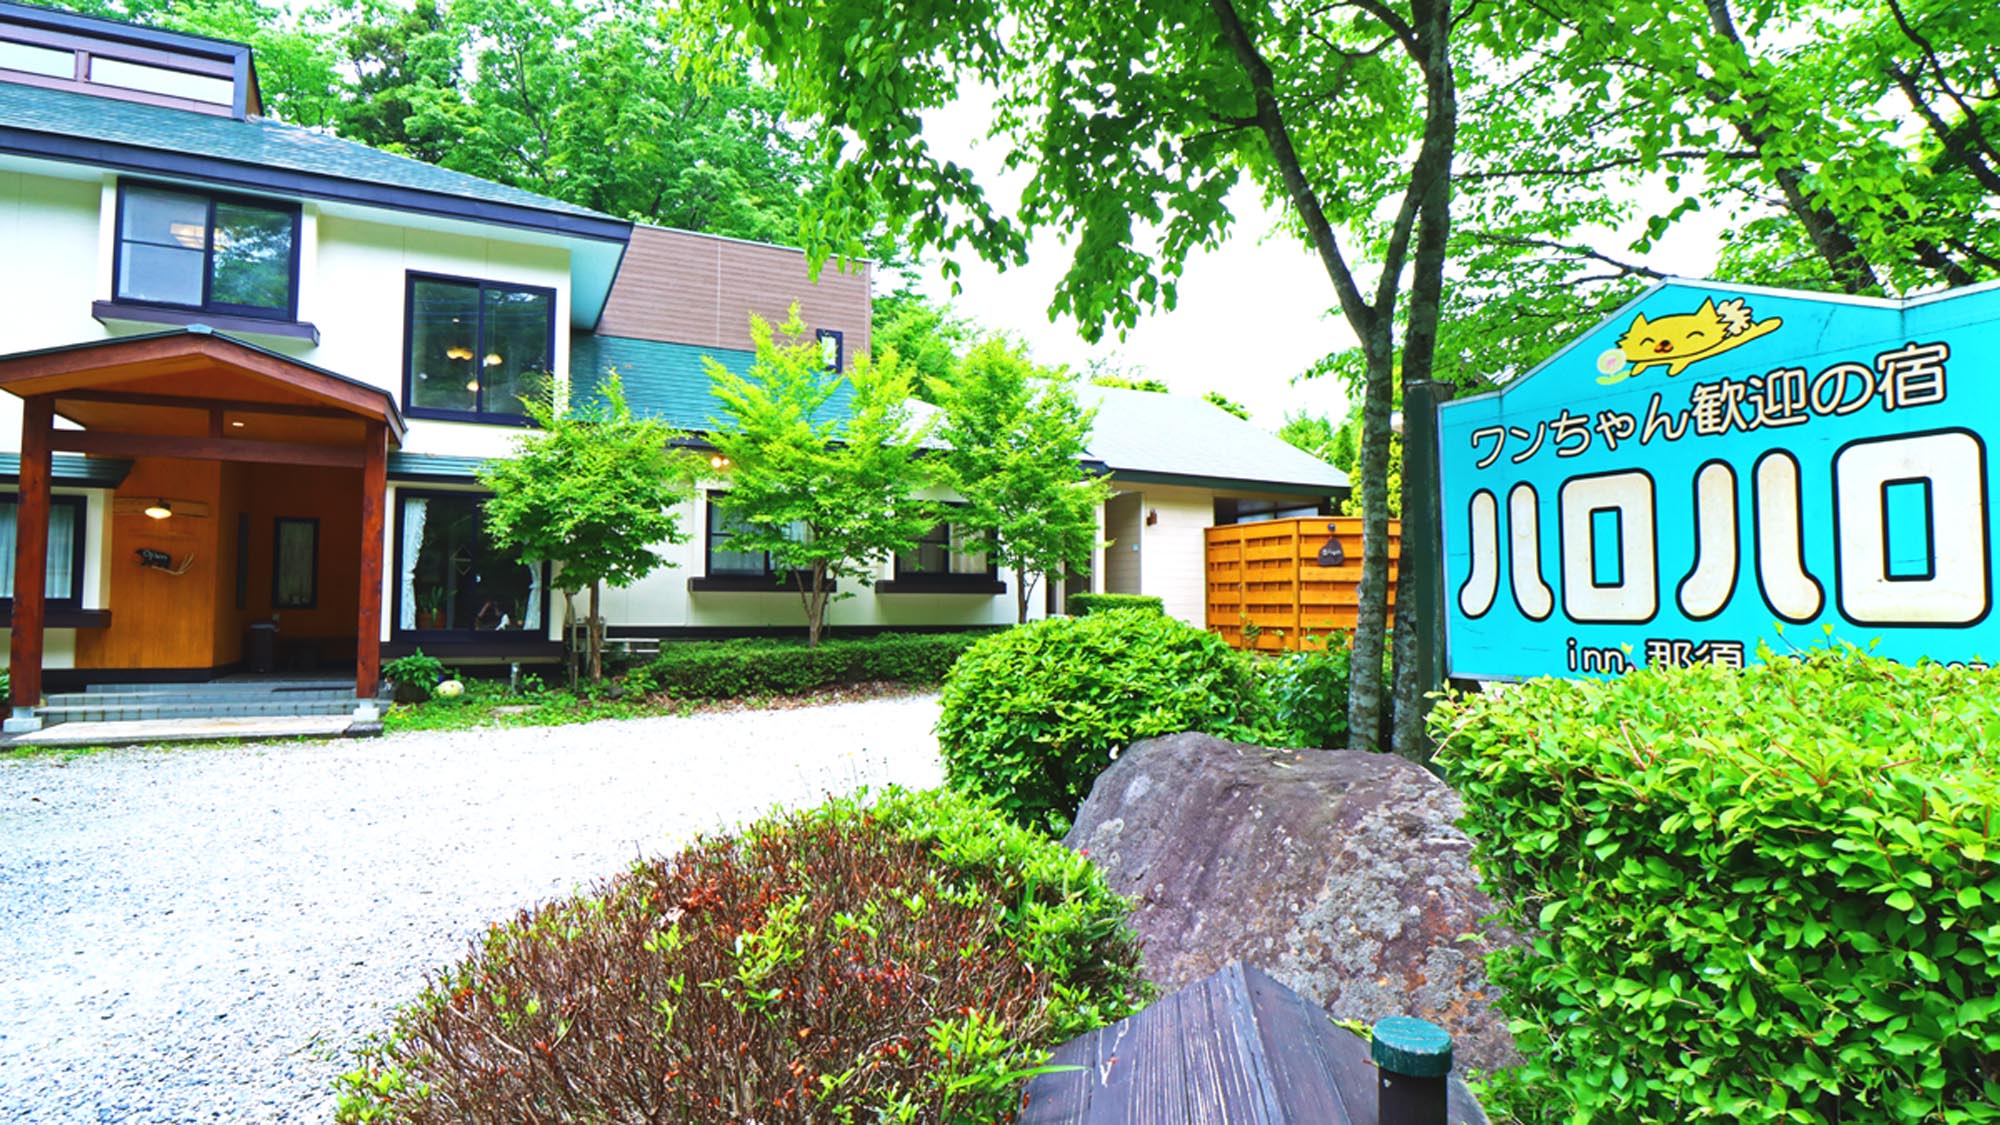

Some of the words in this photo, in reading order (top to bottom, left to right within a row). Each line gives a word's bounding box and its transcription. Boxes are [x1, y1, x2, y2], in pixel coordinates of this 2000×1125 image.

[1471, 342, 1950, 470] ワンちゃん歓迎の宿
[1458, 426, 1993, 629] ハロハロ
